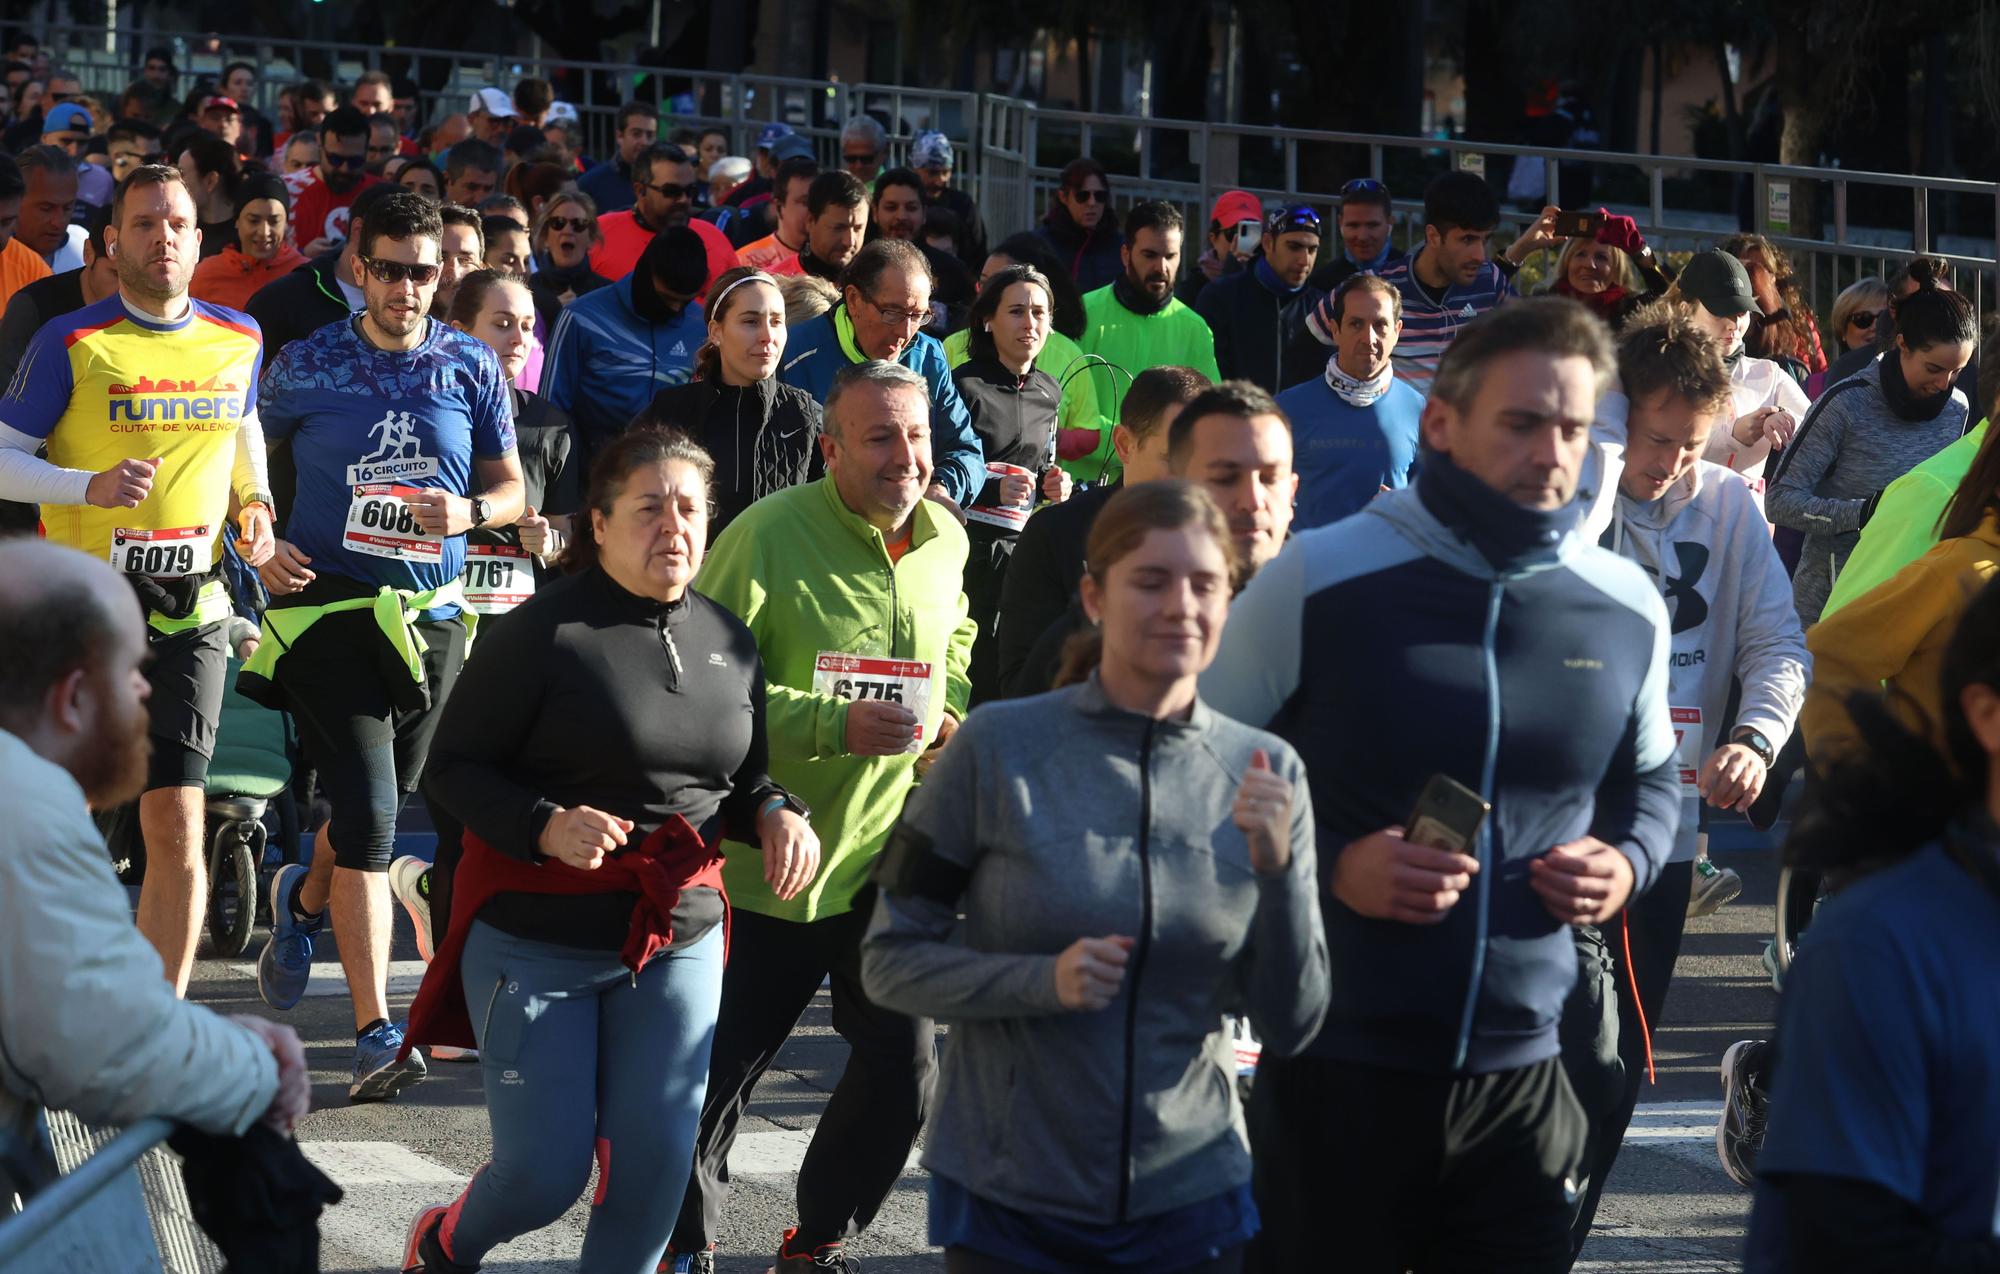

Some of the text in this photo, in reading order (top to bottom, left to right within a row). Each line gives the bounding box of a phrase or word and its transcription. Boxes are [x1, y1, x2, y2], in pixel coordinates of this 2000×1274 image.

[109, 397, 240, 421] runners
[110, 423, 157, 433] CIUTAT
[162, 423, 180, 432] DE
[353, 467, 373, 482] 16
[373, 461, 428, 475] CIRCUITO
[125, 544, 194, 574] 6079
[464, 560, 514, 588] 7767
